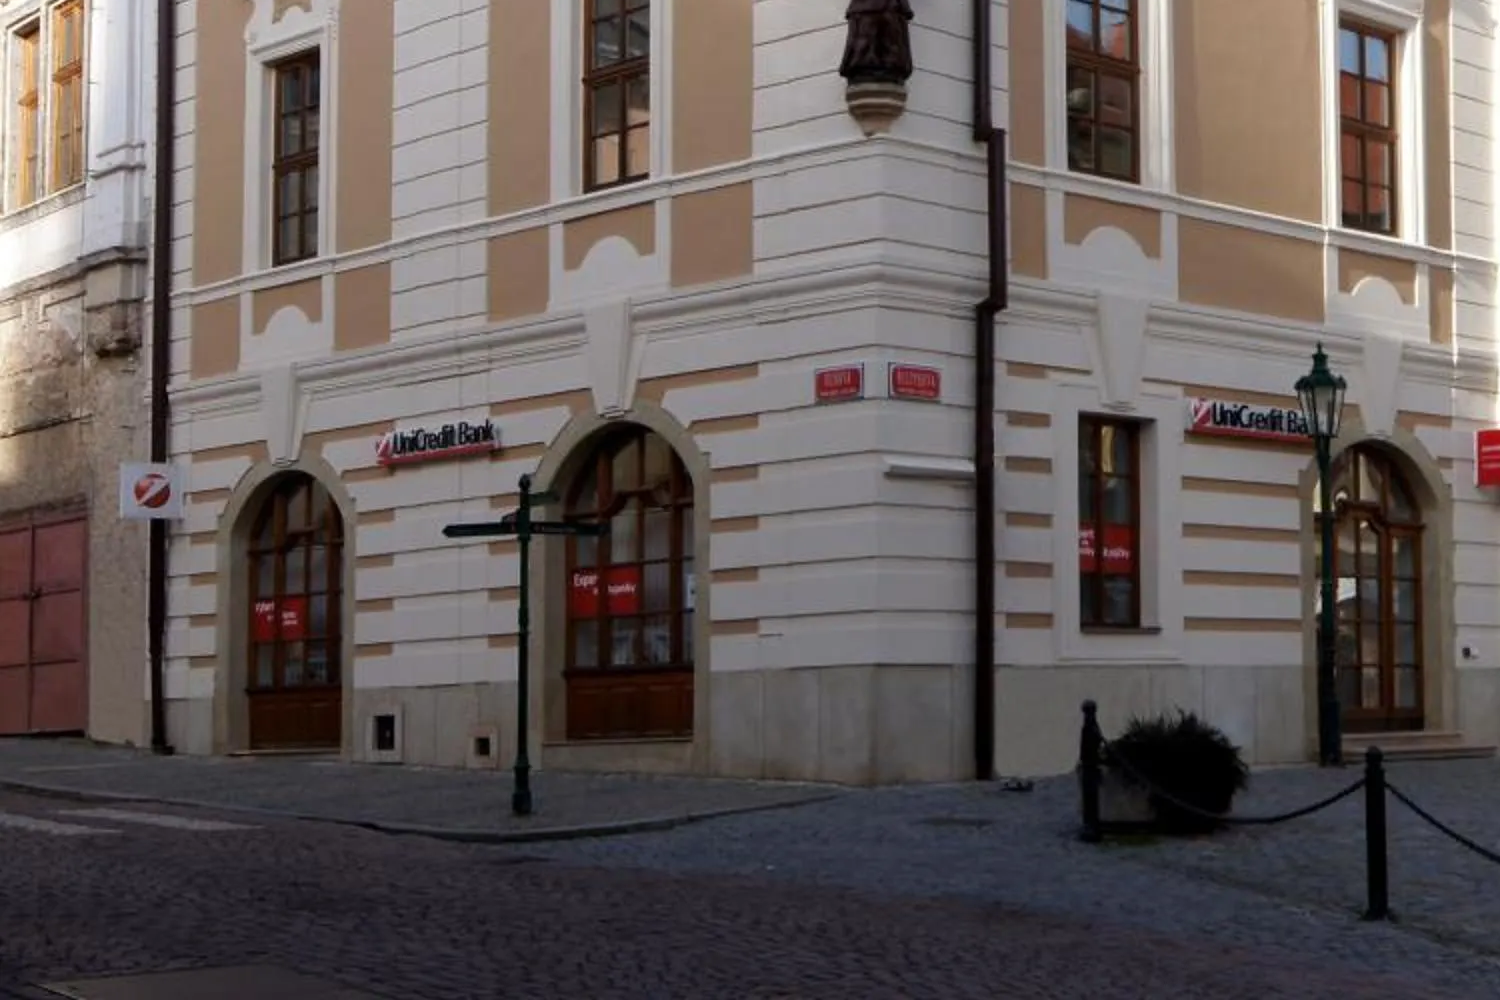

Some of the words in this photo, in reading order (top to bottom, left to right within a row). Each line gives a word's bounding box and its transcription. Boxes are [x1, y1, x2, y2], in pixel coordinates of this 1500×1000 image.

[1211, 400, 1283, 431] UniCredit
[393, 424, 456, 454] UniCredit
[459, 418, 495, 444] Bank
